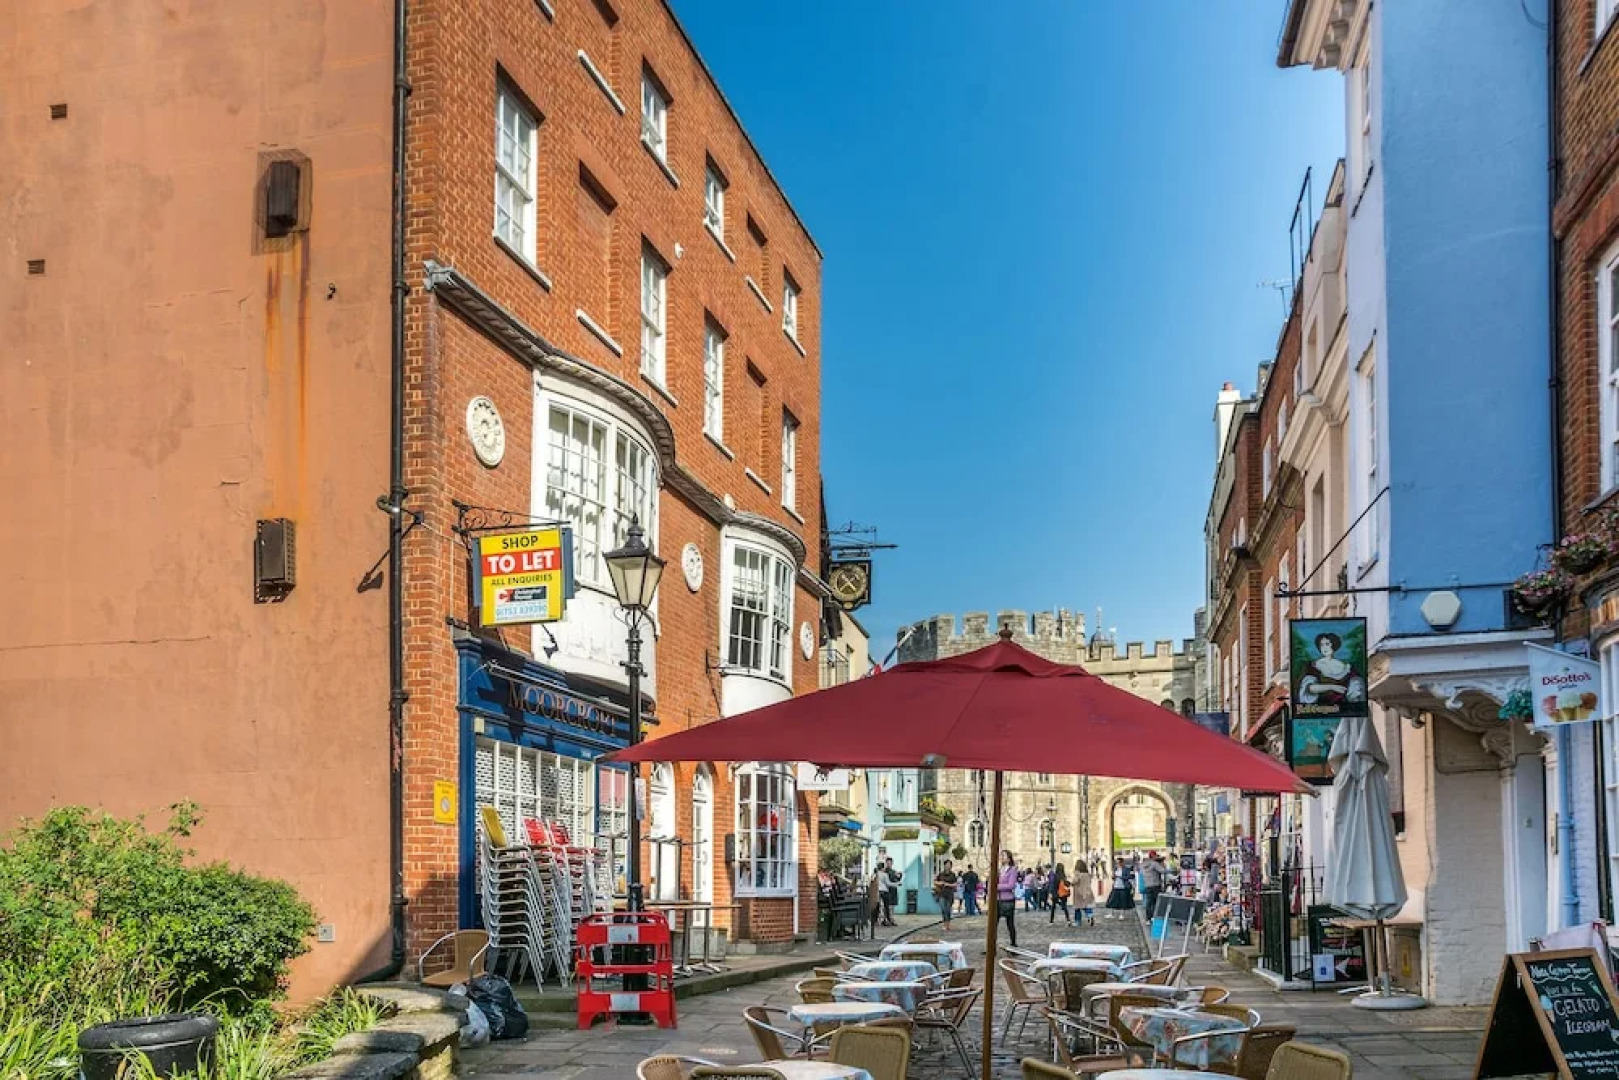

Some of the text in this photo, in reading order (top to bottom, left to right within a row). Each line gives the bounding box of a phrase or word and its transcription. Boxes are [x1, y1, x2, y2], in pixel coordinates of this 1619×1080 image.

[502, 535, 538, 549] SHOP
[487, 550, 554, 574] TO LET
[491, 574, 553, 586] ALL ENQUIRIES
